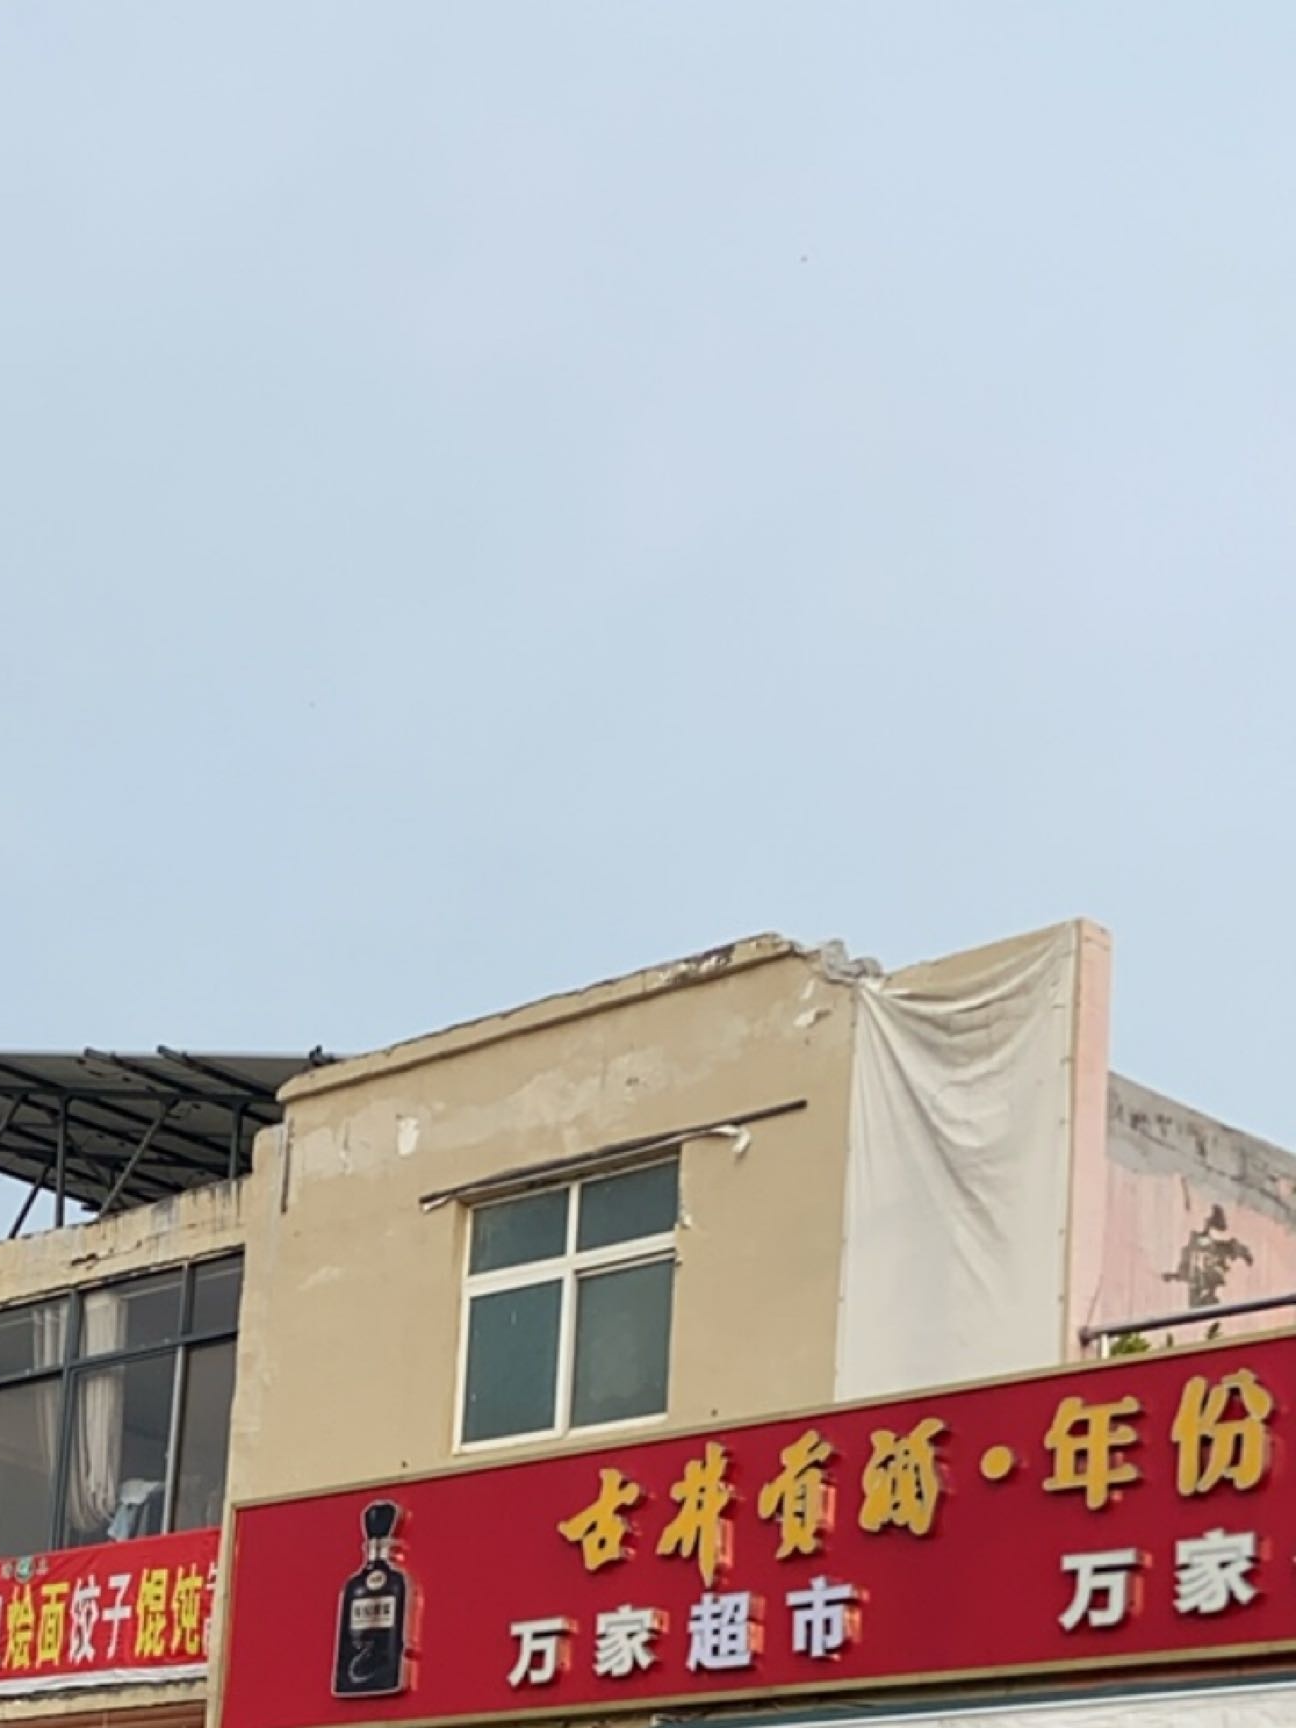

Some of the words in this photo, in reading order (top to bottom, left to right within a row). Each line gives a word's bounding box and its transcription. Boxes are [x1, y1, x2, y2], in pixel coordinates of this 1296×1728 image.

[508, 1576, 854, 1687] 万家超市
[1058, 1527, 1257, 1631] 万家
